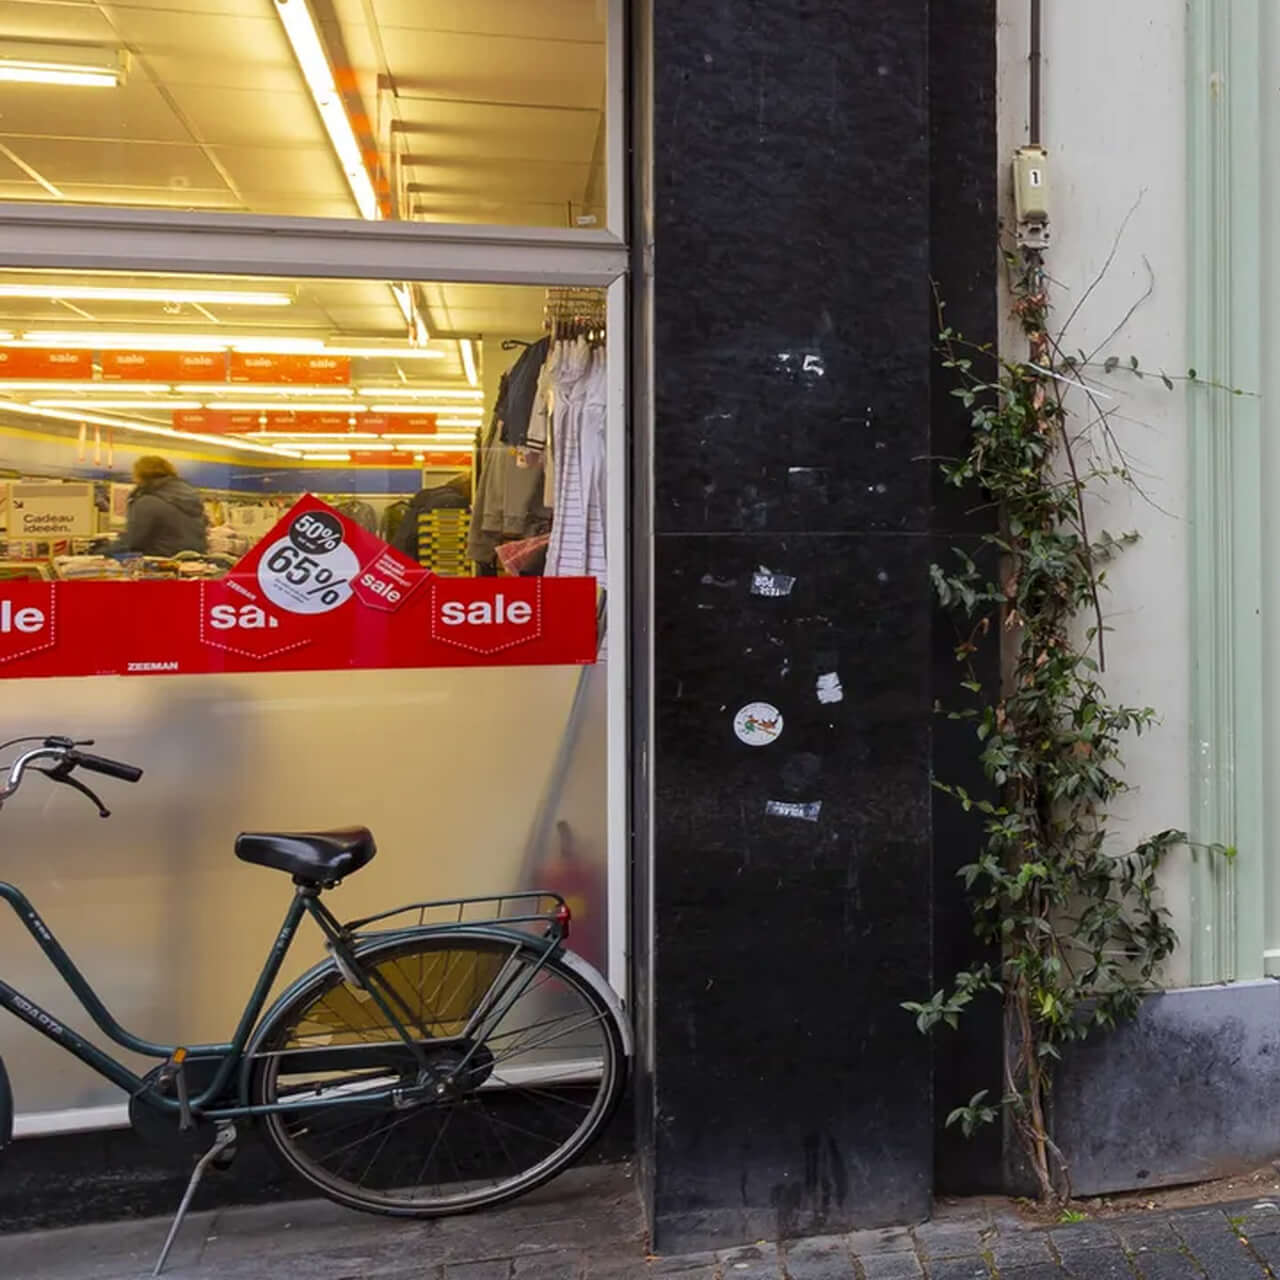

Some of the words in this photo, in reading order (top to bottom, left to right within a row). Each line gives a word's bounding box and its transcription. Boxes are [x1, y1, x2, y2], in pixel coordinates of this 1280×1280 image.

[50, 353, 78, 363] sale
[117, 354, 145, 364] sale
[184, 355, 212, 366] sale
[245, 357, 272, 368] sale
[310, 359, 336, 369] sale
[23, 513, 75, 524] Cadeau
[294, 515, 341, 550] 50%
[266, 546, 347, 606] 65%
[360, 573, 401, 603] sale
[440, 593, 533, 625] sale
[0, 600, 46, 632] le
[209, 604, 279, 629] sa
[127, 662, 179, 671] ZEEMAN
